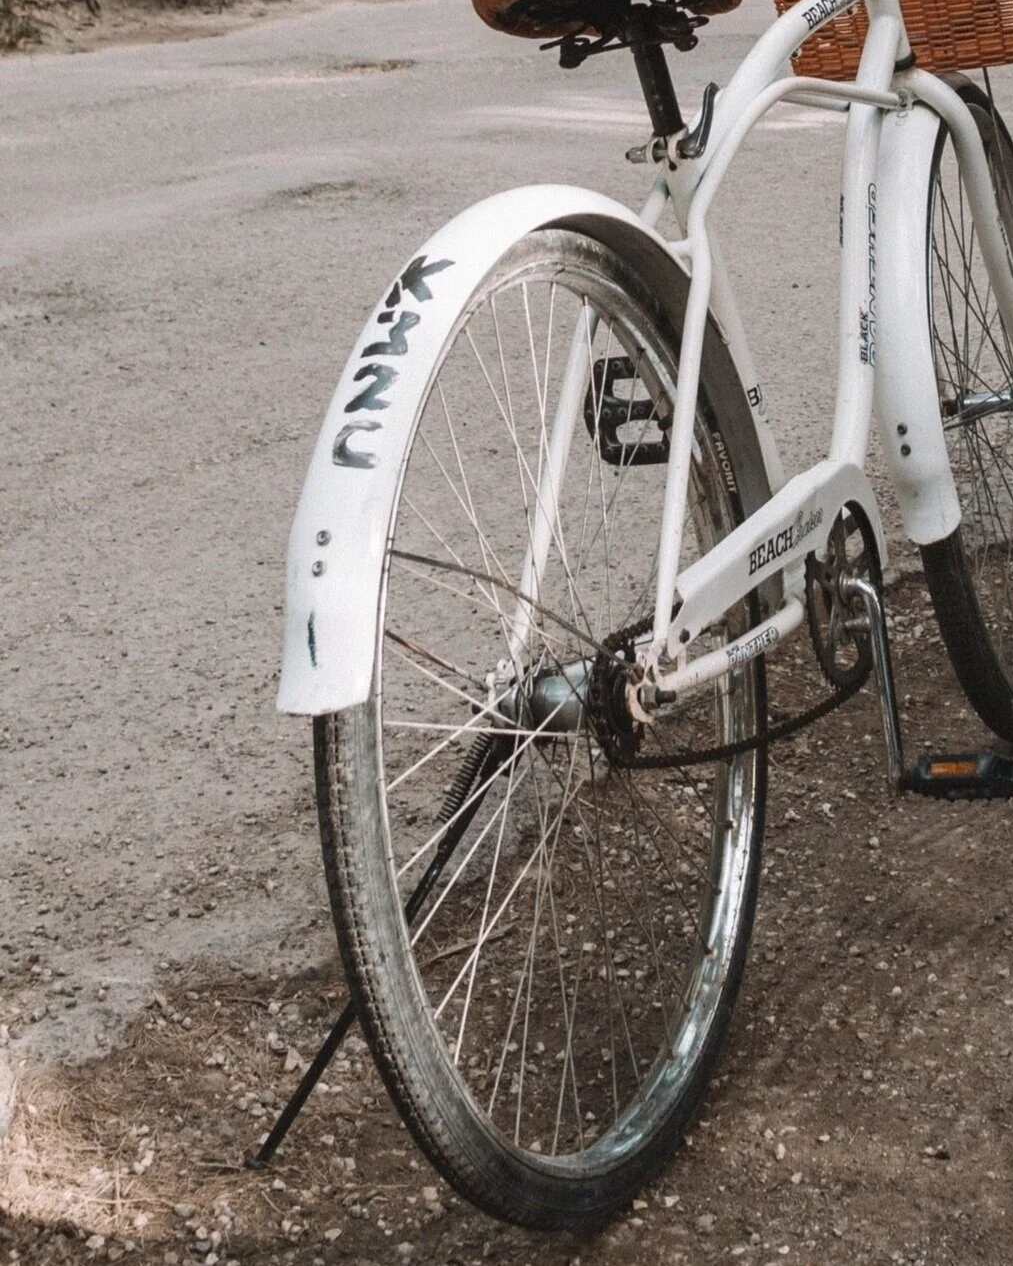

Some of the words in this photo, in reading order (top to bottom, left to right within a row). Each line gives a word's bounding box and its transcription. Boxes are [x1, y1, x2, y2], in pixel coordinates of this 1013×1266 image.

[860, 310, 868, 365] BLACK
[712, 431, 737, 493] FAVORIT
[749, 525, 794, 576] BEACH
